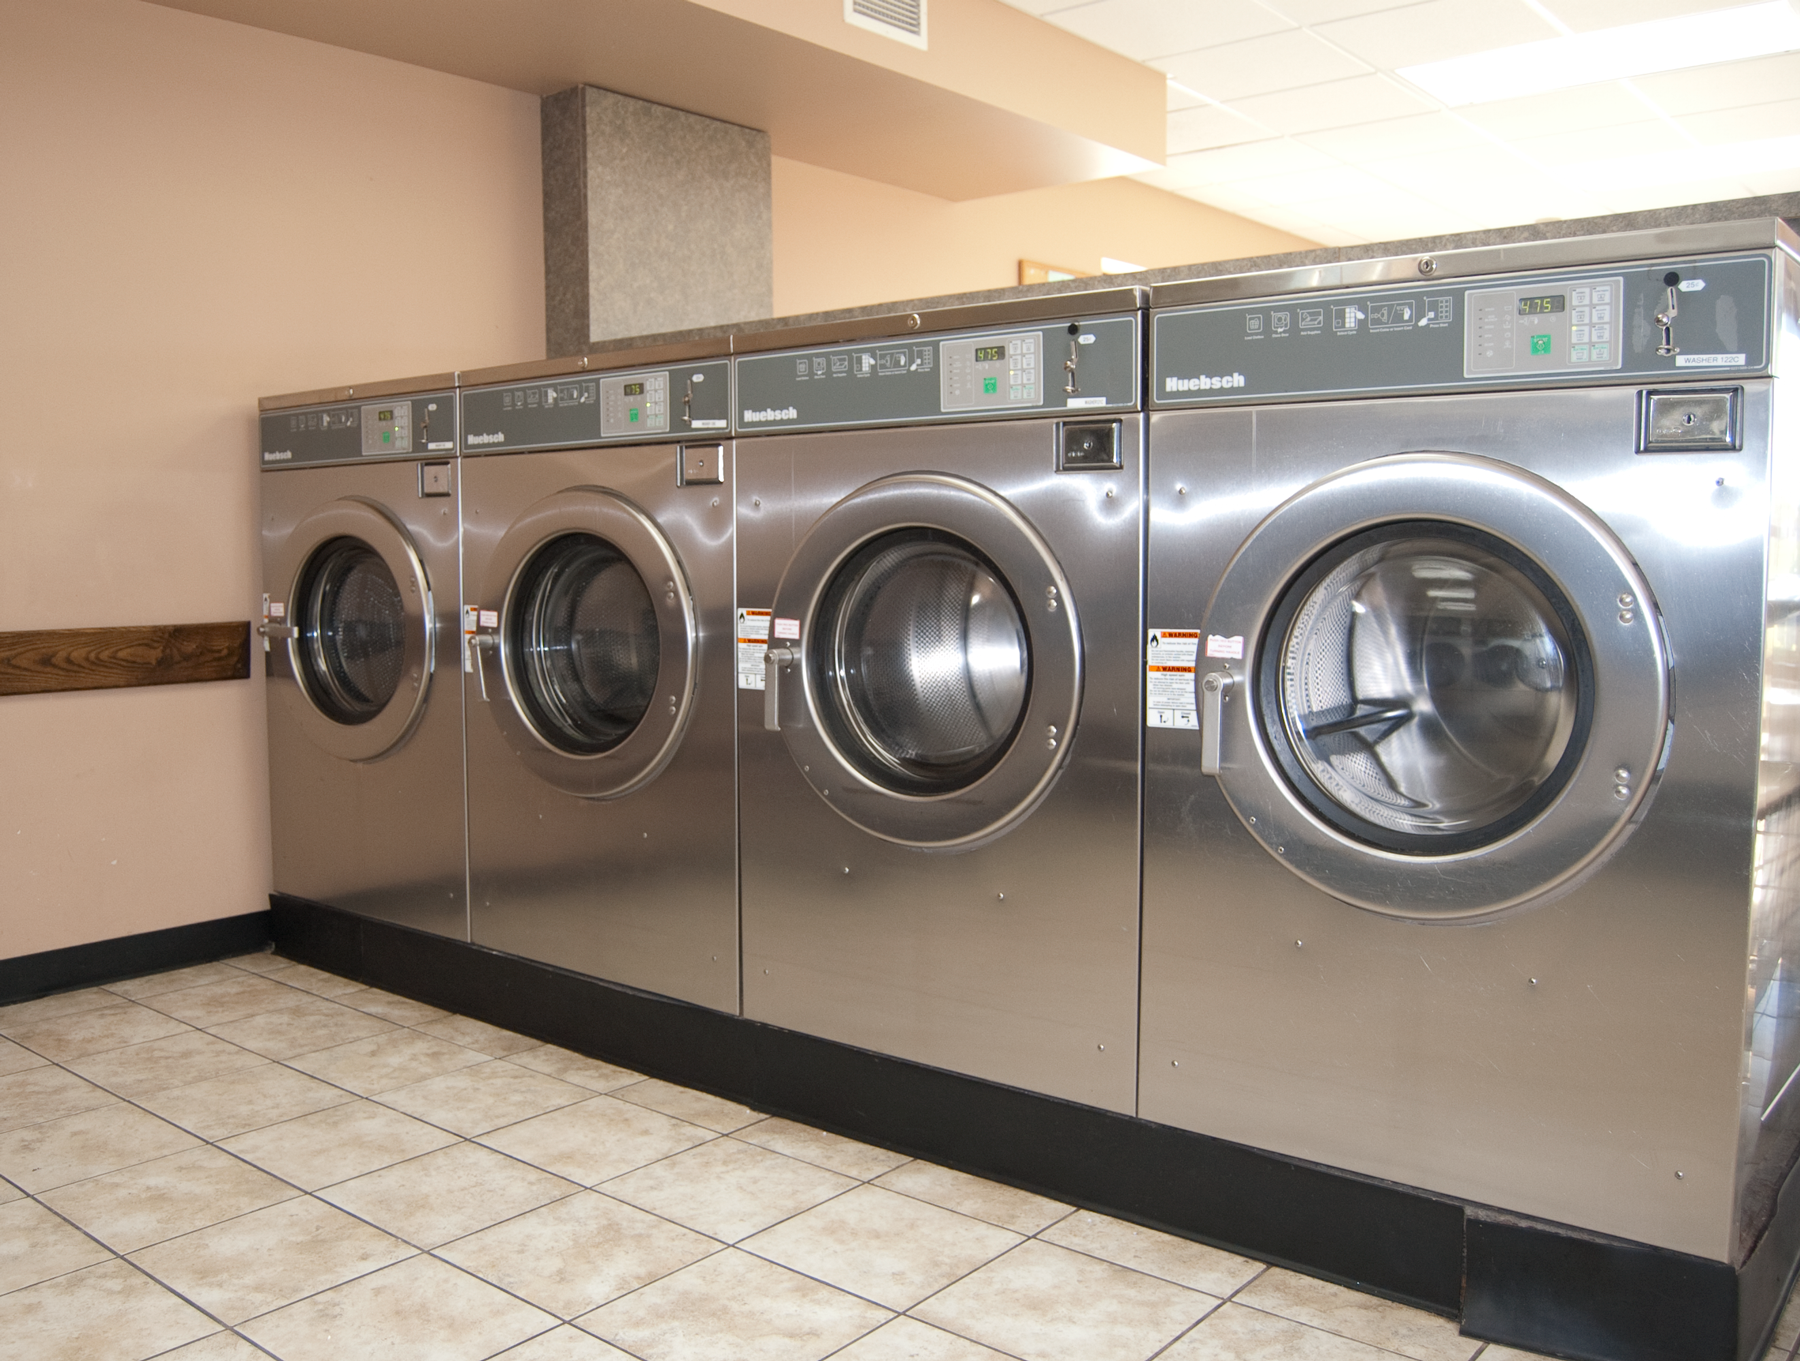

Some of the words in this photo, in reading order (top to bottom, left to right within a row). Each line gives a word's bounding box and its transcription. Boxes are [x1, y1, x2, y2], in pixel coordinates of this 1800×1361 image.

[1521, 298, 1551, 313] 475
[978, 348, 998, 360] 475
[1684, 356, 1718, 364] WASHER
[1165, 372, 1245, 392] Huebsch
[743, 406, 797, 422] Huebsch
[467, 431, 505, 446] Huebsch
[264, 450, 292, 461] Huebsch
